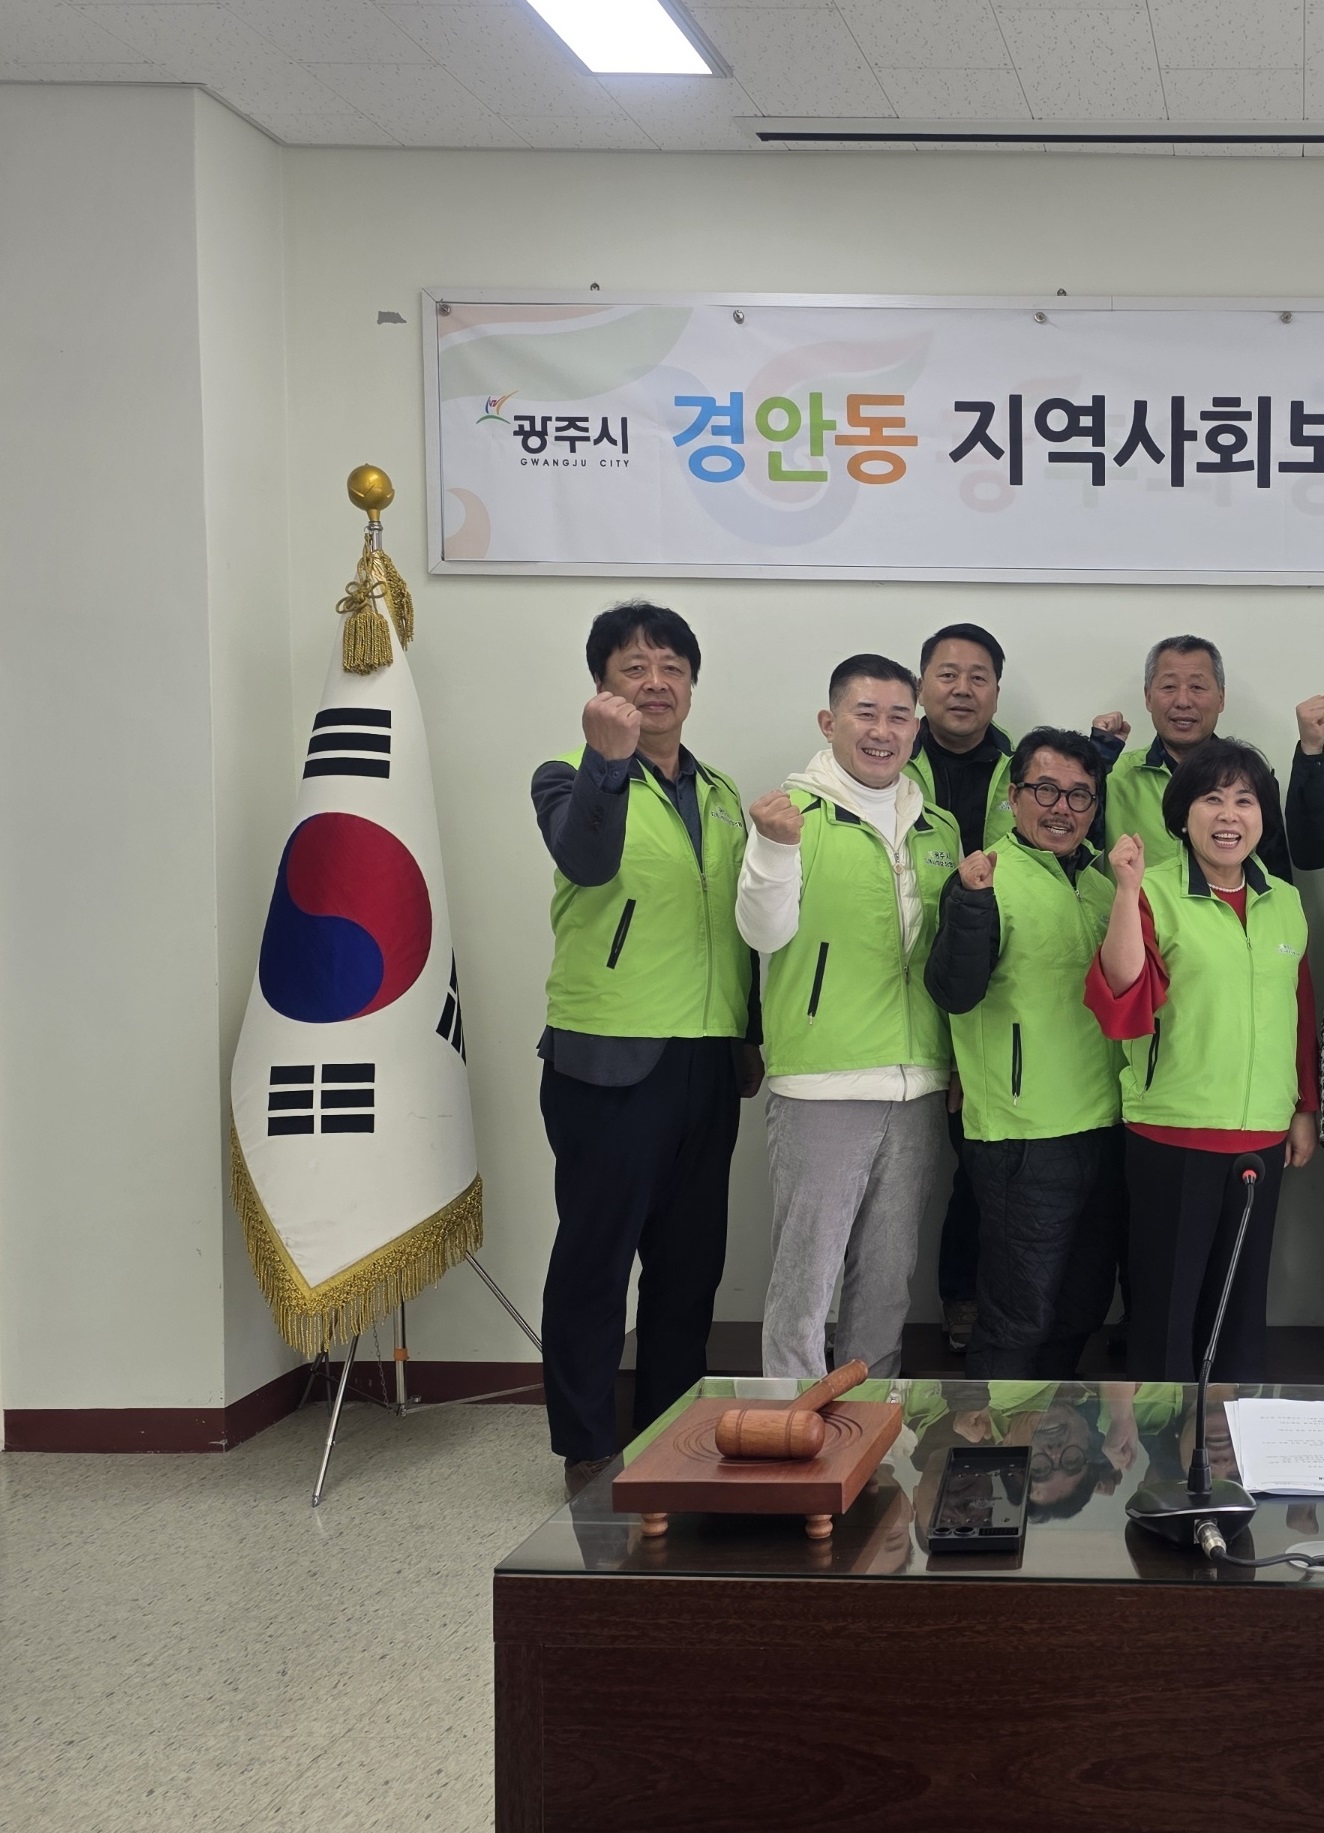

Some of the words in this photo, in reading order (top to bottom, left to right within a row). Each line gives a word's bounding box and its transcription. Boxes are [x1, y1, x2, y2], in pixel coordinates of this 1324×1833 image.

[512, 414, 629, 455] 광주시
[673, 391, 919, 486] 경안동
[520, 457, 587, 467] GWANGJU
[599, 459, 630, 468] CITY
